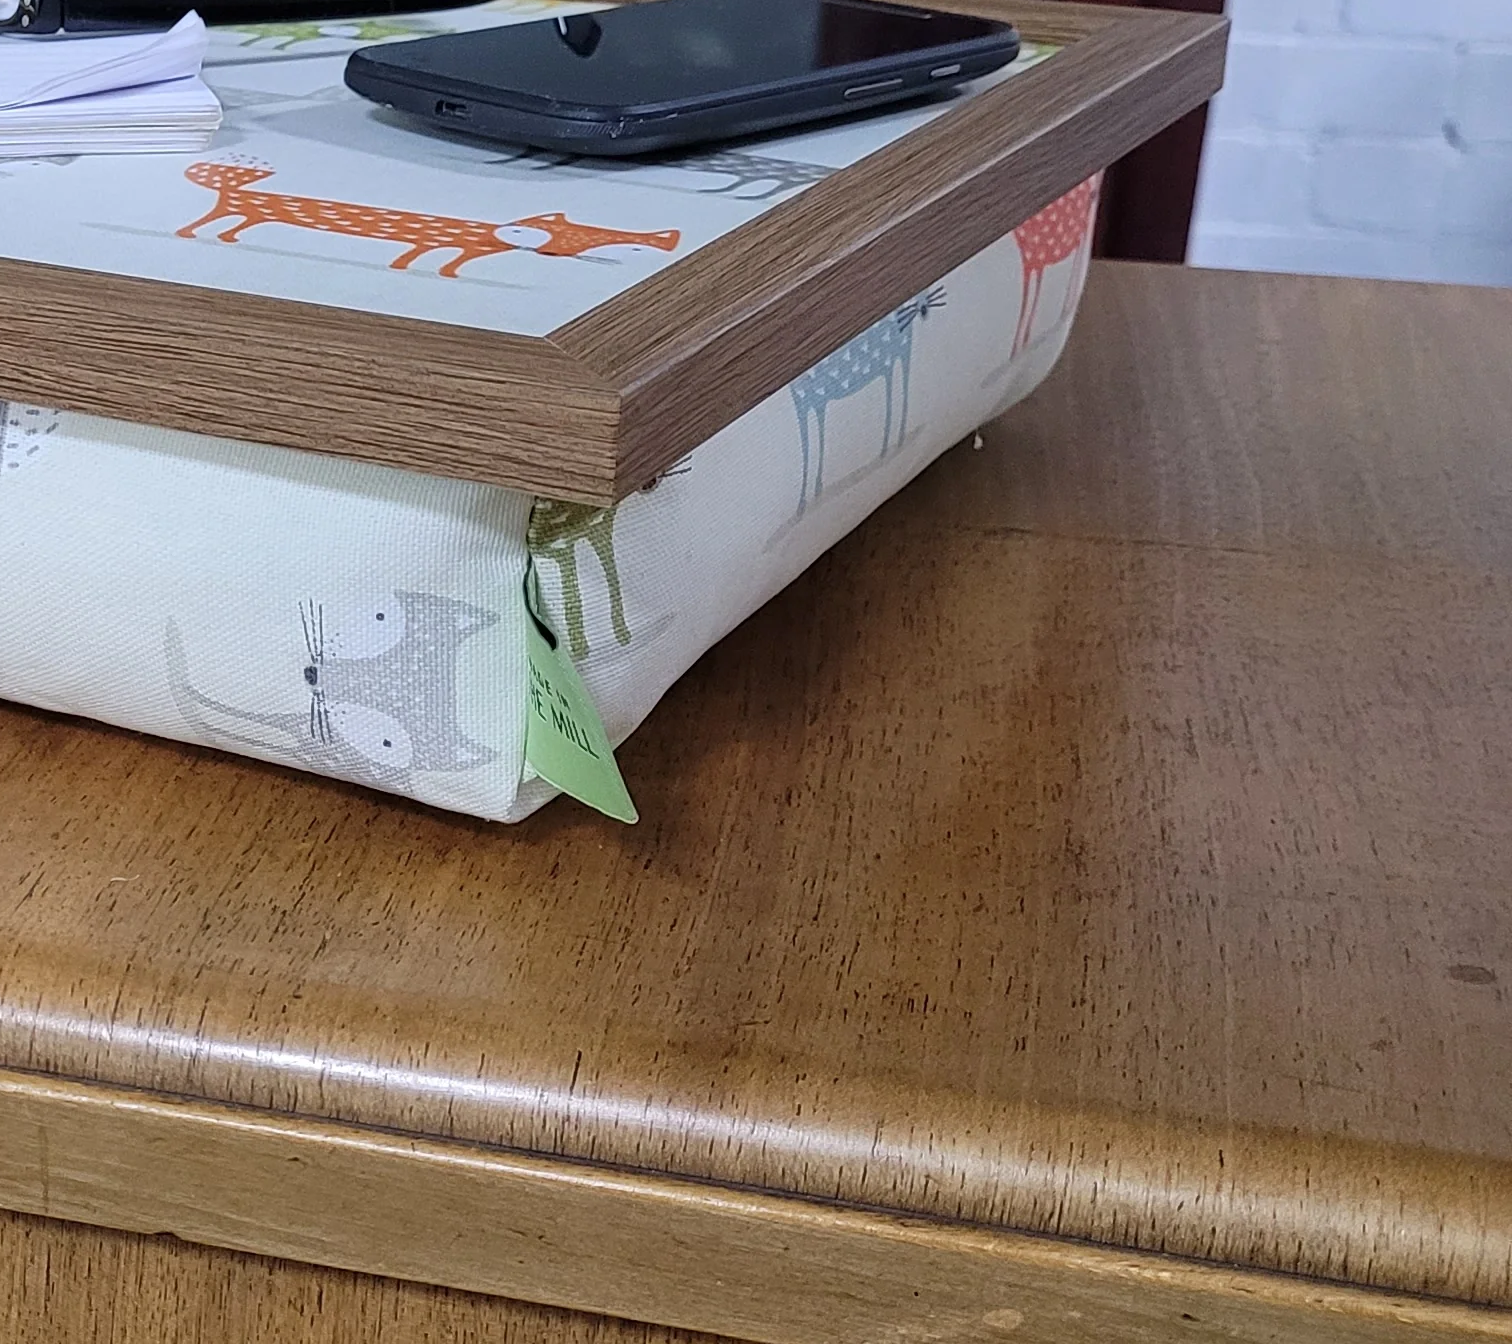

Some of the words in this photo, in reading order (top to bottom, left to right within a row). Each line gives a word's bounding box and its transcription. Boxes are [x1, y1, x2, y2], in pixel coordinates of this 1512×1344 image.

[529, 656, 553, 697] ADE
[555, 689, 571, 712] IN
[529, 678, 547, 722] HE
[550, 703, 600, 759] MILL
